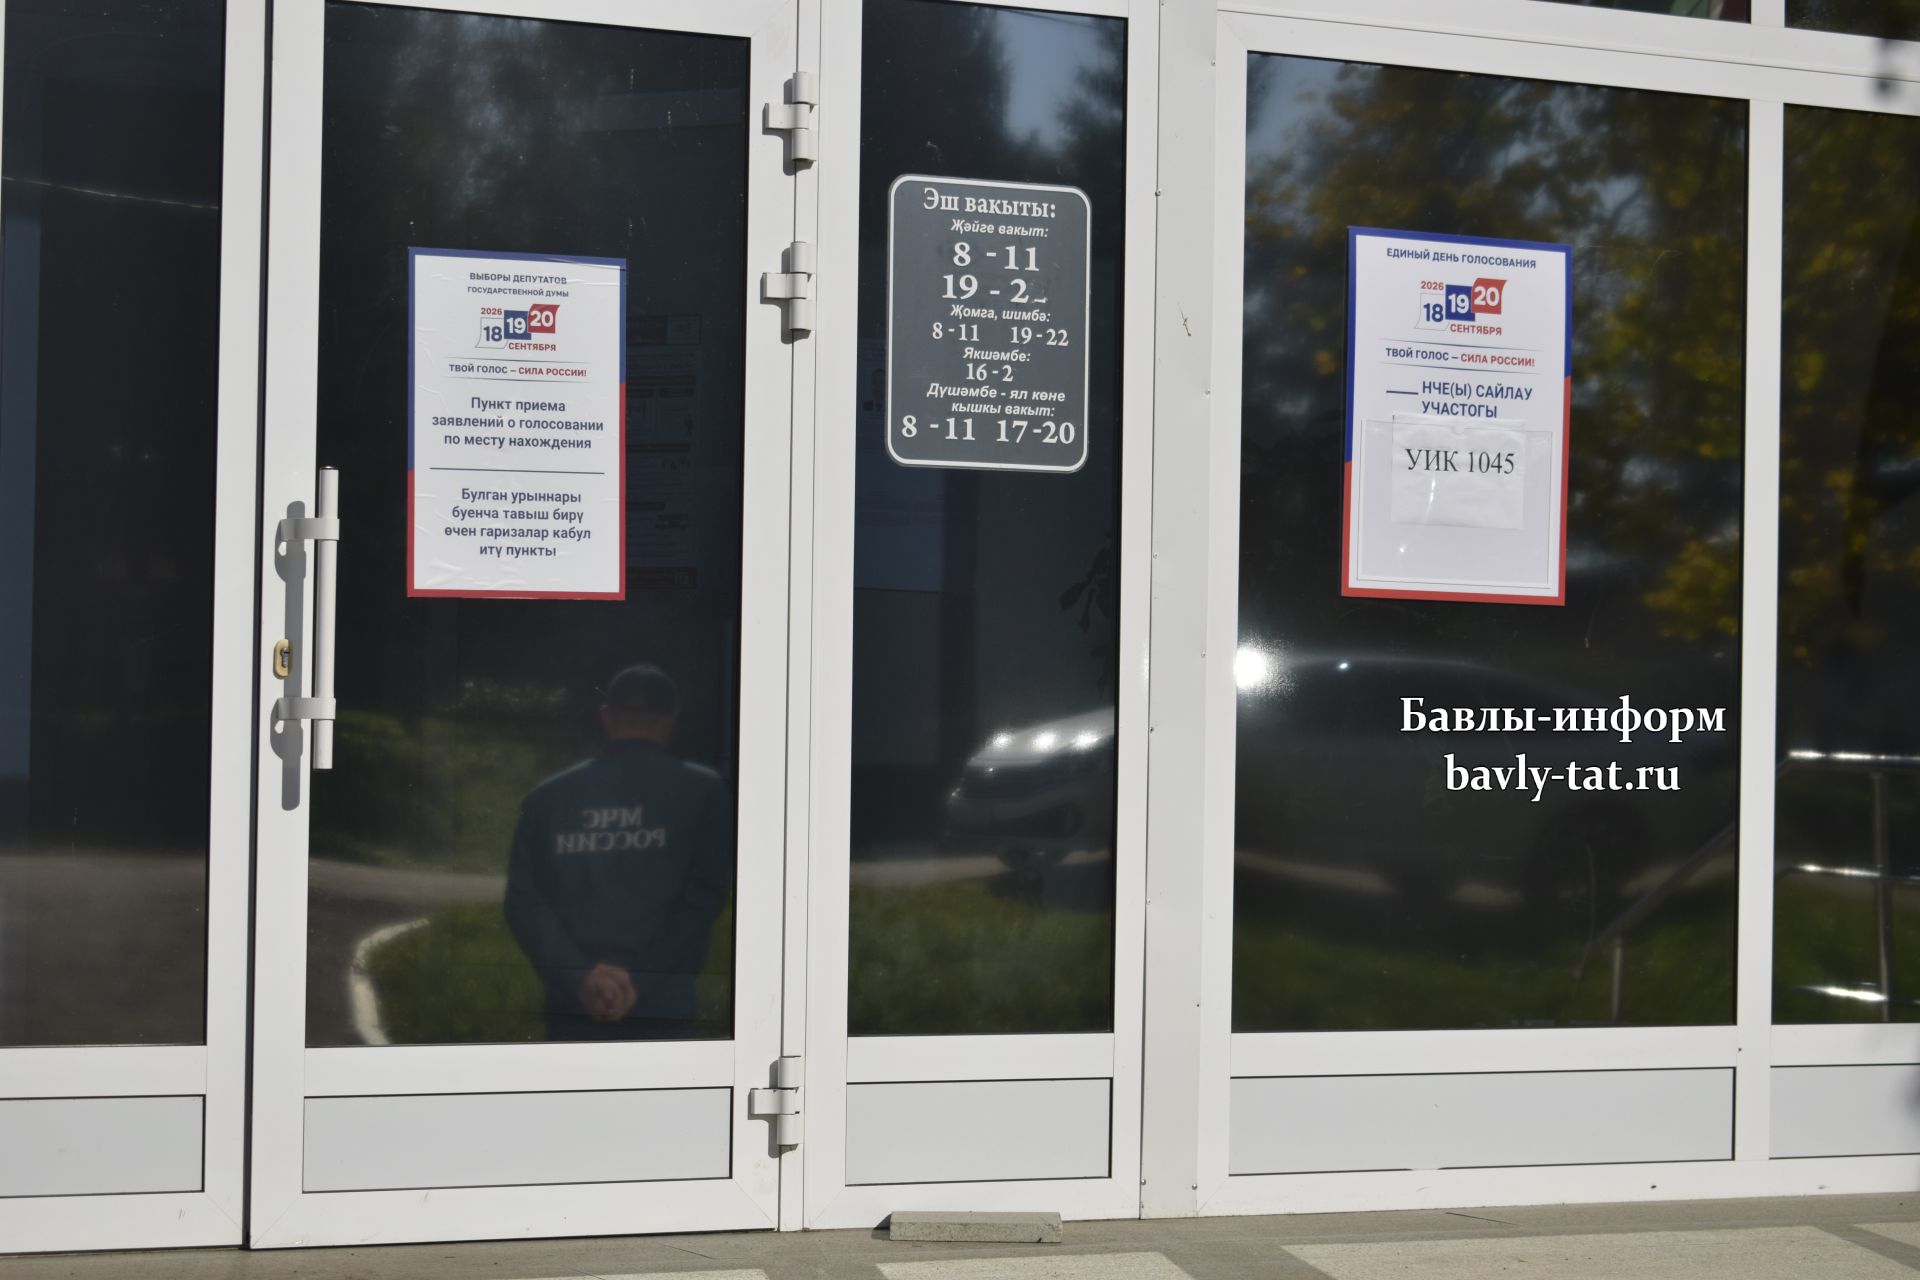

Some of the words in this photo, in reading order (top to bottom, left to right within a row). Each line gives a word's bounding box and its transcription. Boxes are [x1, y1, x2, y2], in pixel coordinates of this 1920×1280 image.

[923, 188, 959, 211] Эш
[965, 197, 1056, 218] вакыты:
[950, 219, 994, 234] Җәйге
[999, 225, 1048, 237] вакыт:
[1386, 248, 1430, 260] ЕДИНЫЙ
[1432, 252, 1459, 262] ДЕНЬ
[1462, 254, 1536, 268] ГОЛОСОВАНИЯ
[470, 272, 511, 282] ВЫБОРЫ
[513, 274, 567, 284] ДЕПУТАТОВ
[1421, 281, 1444, 290] 2026
[468, 286, 544, 297] ГОСУДАРСТВЕННОЙ
[546, 289, 569, 298] ДУМЫ
[1010, 279, 1048, 303] 2
[1423, 304, 1444, 322] 18
[1448, 294, 1469, 313] 19
[1474, 287, 1499, 306] 20
[950, 304, 998, 320] Җомга,
[1002, 309, 1051, 322] шимбә:
[483, 326, 502, 341] 18
[506, 317, 526, 334] 19
[530, 311, 554, 327] 20
[1450, 324, 1502, 335] СЕНТЯБРЯ
[508, 342, 556, 352] СЕНТЯБРЯ
[963, 347, 1031, 362] Якшәмбе:
[1386, 347, 1412, 359] ТВОЙ
[1415, 350, 1449, 360] ГОЛОС
[1461, 354, 1488, 363] СИЛА
[1491, 356, 1535, 366] РОССИИ!
[449, 363, 475, 372] ТВОЙ
[477, 365, 507, 374] ГОЛОС
[518, 367, 544, 375] СИЛА
[546, 368, 587, 377] РОССИИ!
[927, 383, 997, 398] Дүшәмбе
[1010, 391, 1027, 400] ял
[1032, 392, 1065, 402] көне
[1422, 381, 1471, 399] НЧЕ(Ы)
[1476, 384, 1532, 400] САЙЛАУ
[471, 397, 512, 411] Пункт
[516, 400, 565, 413] приема
[951, 403, 1000, 414] кышкы
[1005, 404, 1055, 417] вакыт:
[1422, 401, 1497, 418] УЧАСТОГЫ
[432, 415, 504, 428] заявлений
[508, 419, 515, 428] о
[519, 418, 604, 431] голосовании
[444, 435, 460, 444] по
[464, 436, 505, 448] месту
[509, 436, 591, 449] нахождения
[1405, 449, 1458, 471] УИК
[1468, 451, 1514, 474] 1045
[462, 488, 507, 502] Булган
[511, 491, 581, 504] урыннары
[452, 506, 498, 520] буенча
[503, 509, 549, 520] тавыш
[553, 508, 583, 523] бирү
[445, 526, 476, 537] өчен
[480, 526, 548, 541] гаризалар
[553, 526, 591, 541] кабул
[480, 545, 502, 558] итү
[506, 546, 556, 558] пункты
